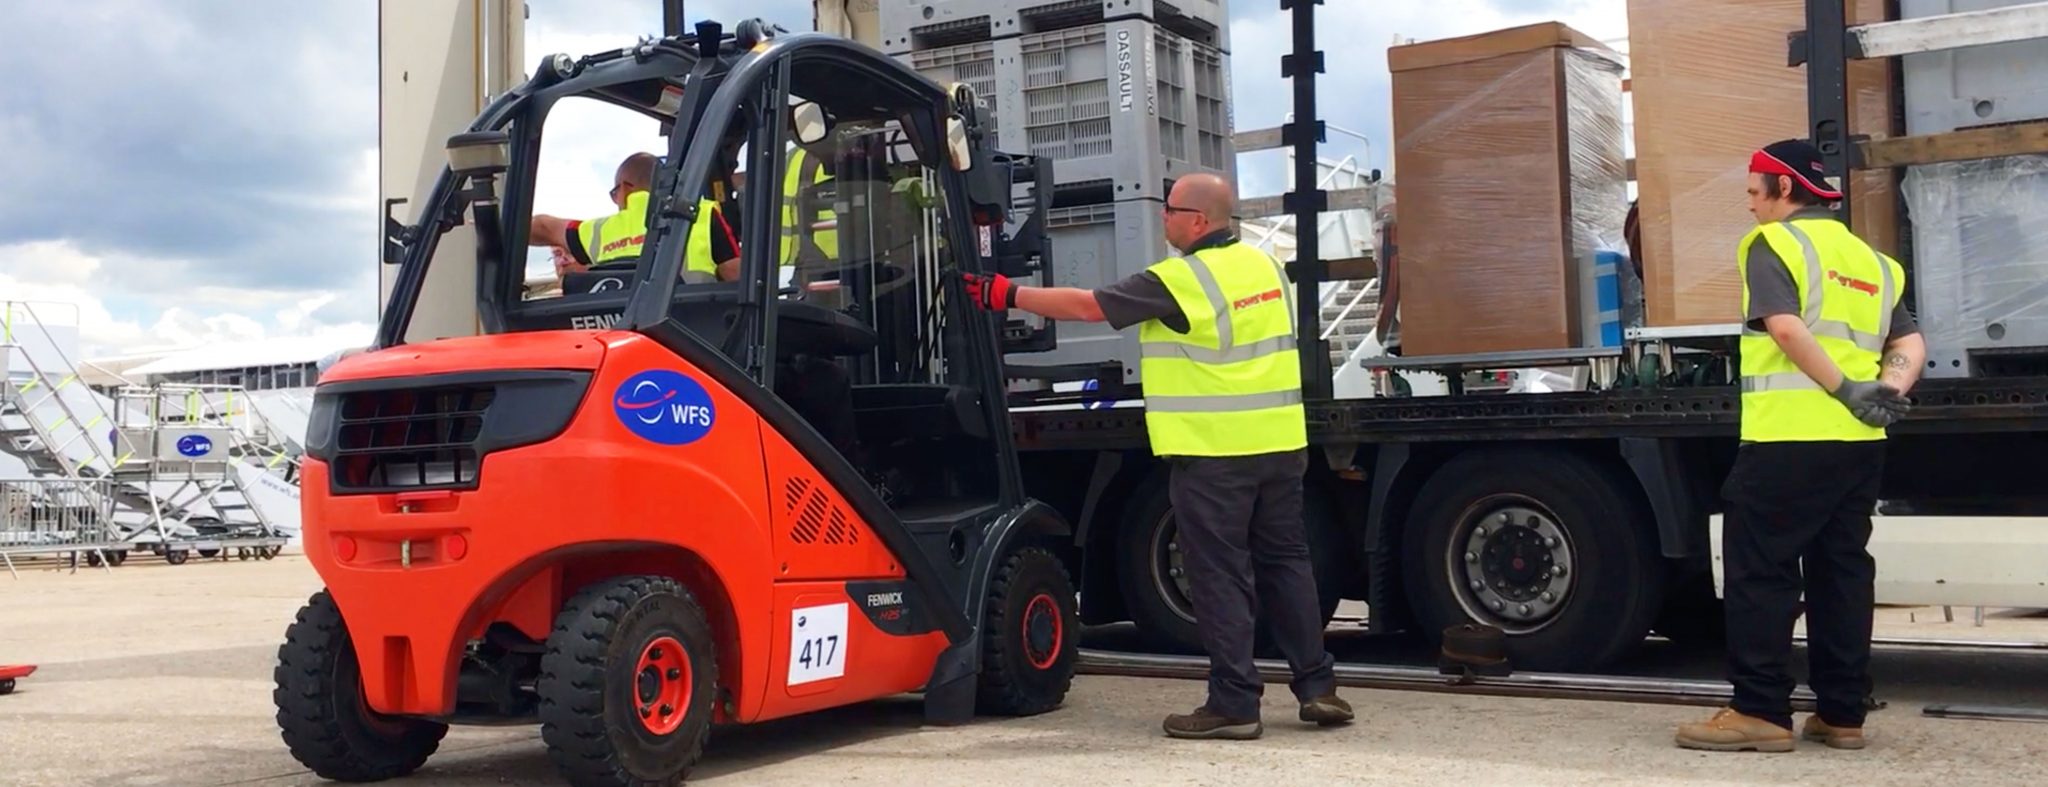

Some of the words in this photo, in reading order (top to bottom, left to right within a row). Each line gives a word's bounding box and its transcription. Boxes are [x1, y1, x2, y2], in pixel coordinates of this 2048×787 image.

[1116, 30, 1133, 111] DASSAULT
[571, 313, 624, 330] FENW
[671, 403, 711, 427] WFS
[867, 591, 903, 606] FENWICK
[798, 634, 838, 670] 417
